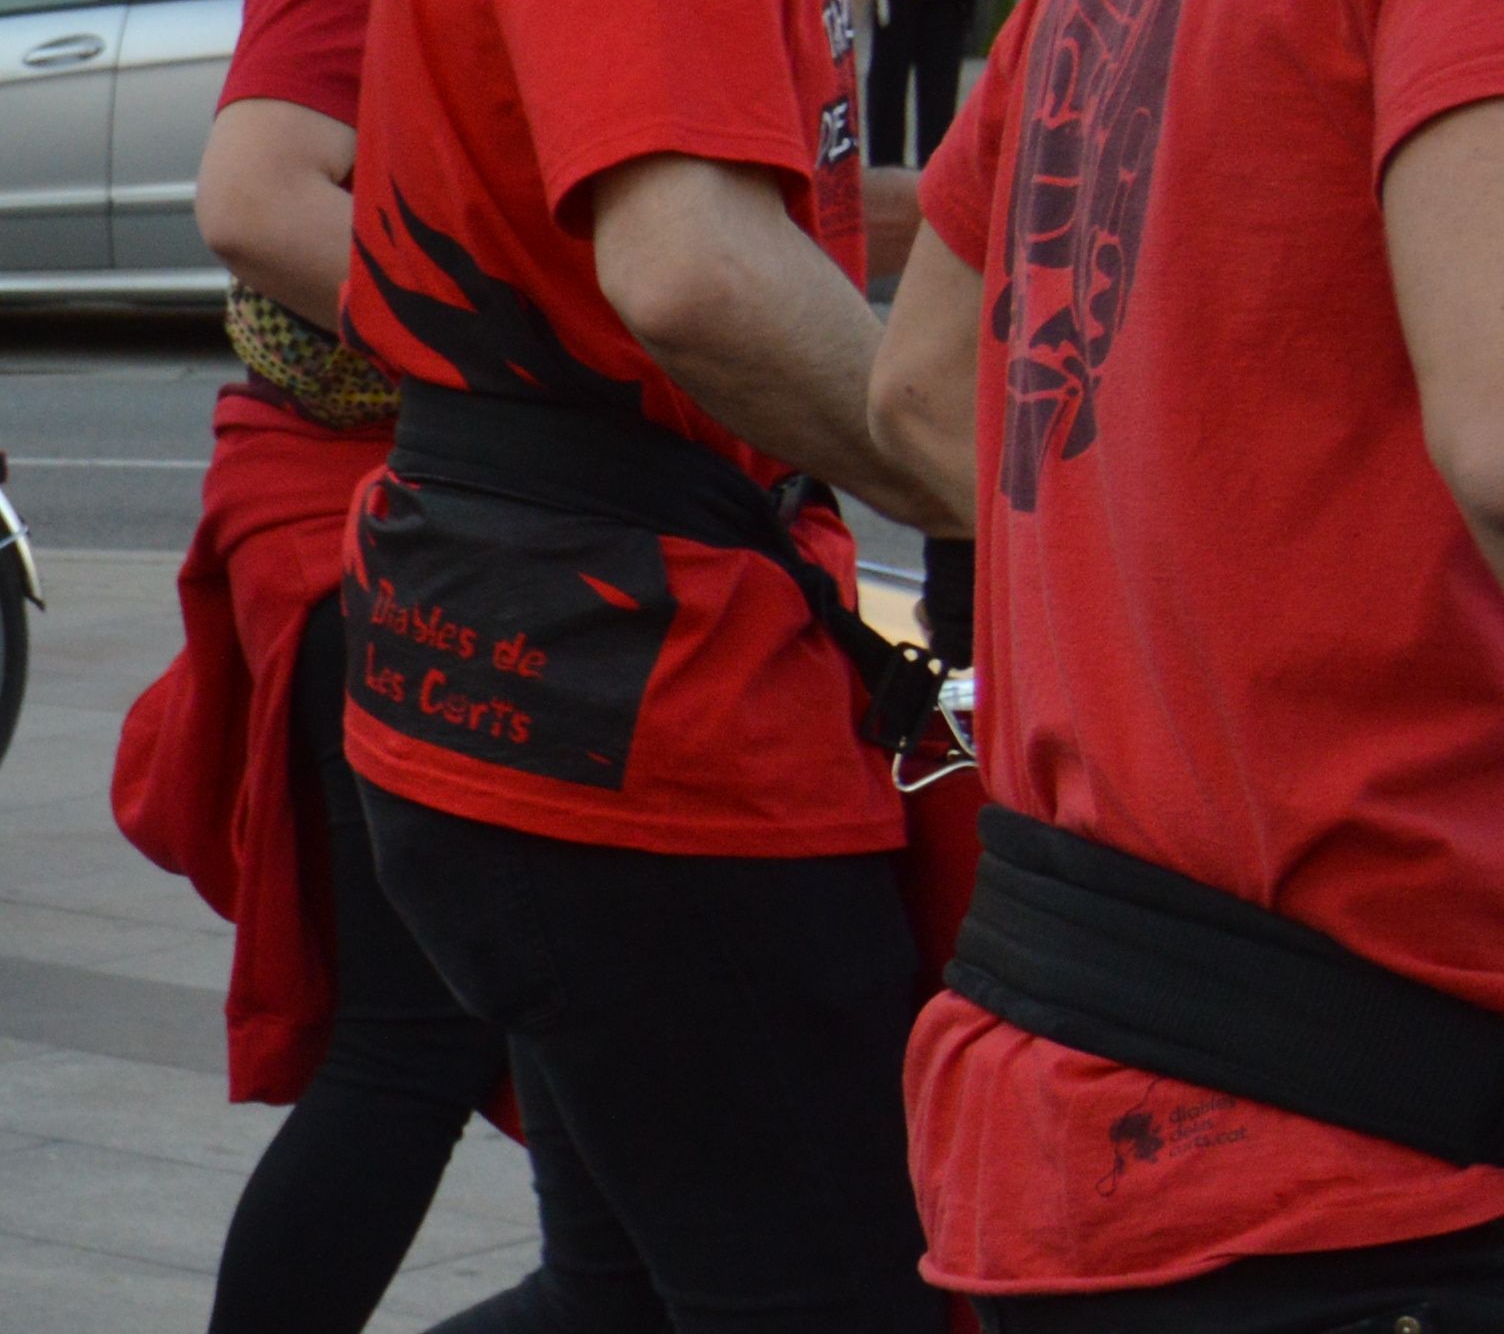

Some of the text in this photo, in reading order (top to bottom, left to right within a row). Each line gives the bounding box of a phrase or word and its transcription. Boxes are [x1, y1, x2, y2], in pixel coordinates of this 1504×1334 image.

[371, 578, 548, 679] Diables de
[365, 642, 533, 744] Les Corts
